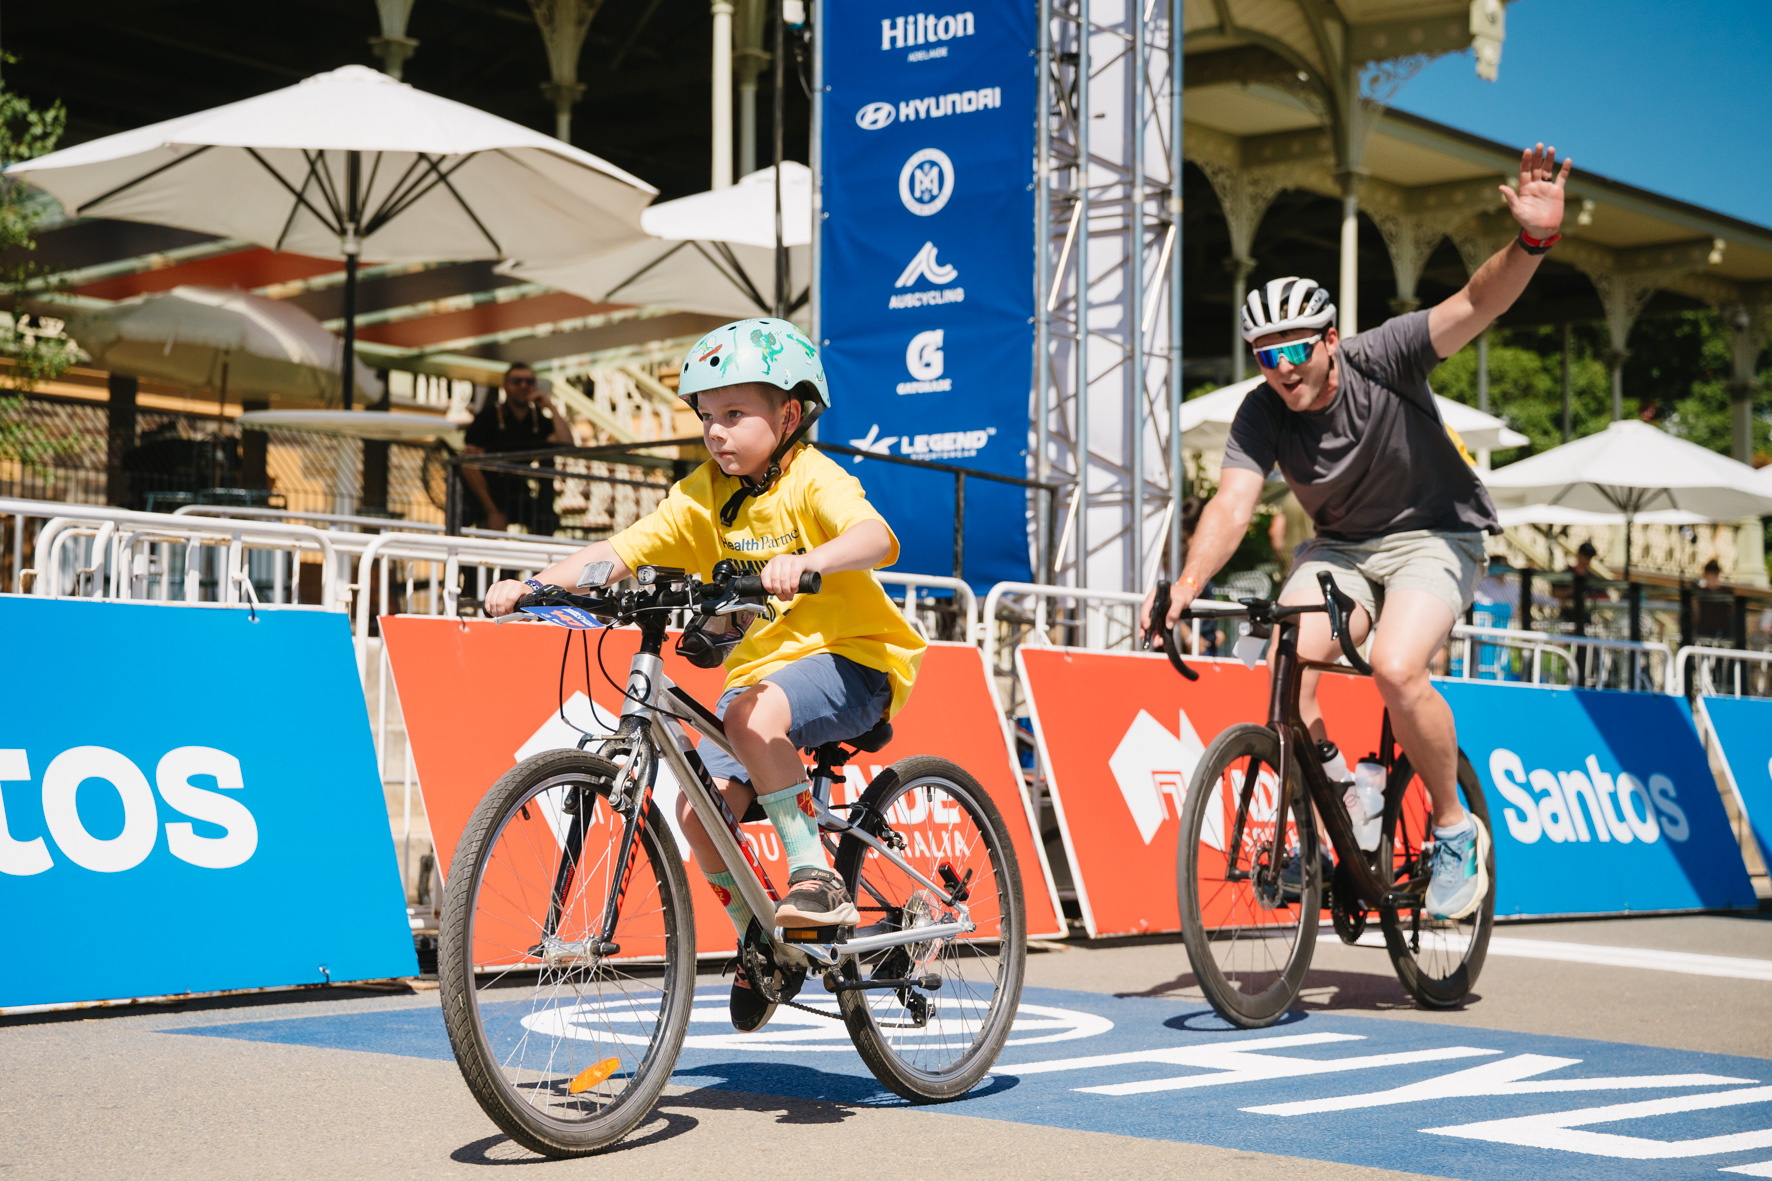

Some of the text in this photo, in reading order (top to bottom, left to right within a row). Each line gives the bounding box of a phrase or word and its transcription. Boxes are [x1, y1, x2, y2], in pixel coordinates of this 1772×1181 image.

[881, 12, 975, 50] Hilton
[899, 87, 1001, 122] HYUNDAI
[889, 287, 965, 309] AUSCYCLING
[901, 430, 988, 454] LEGEND
[1489, 748, 1690, 844] Santos
